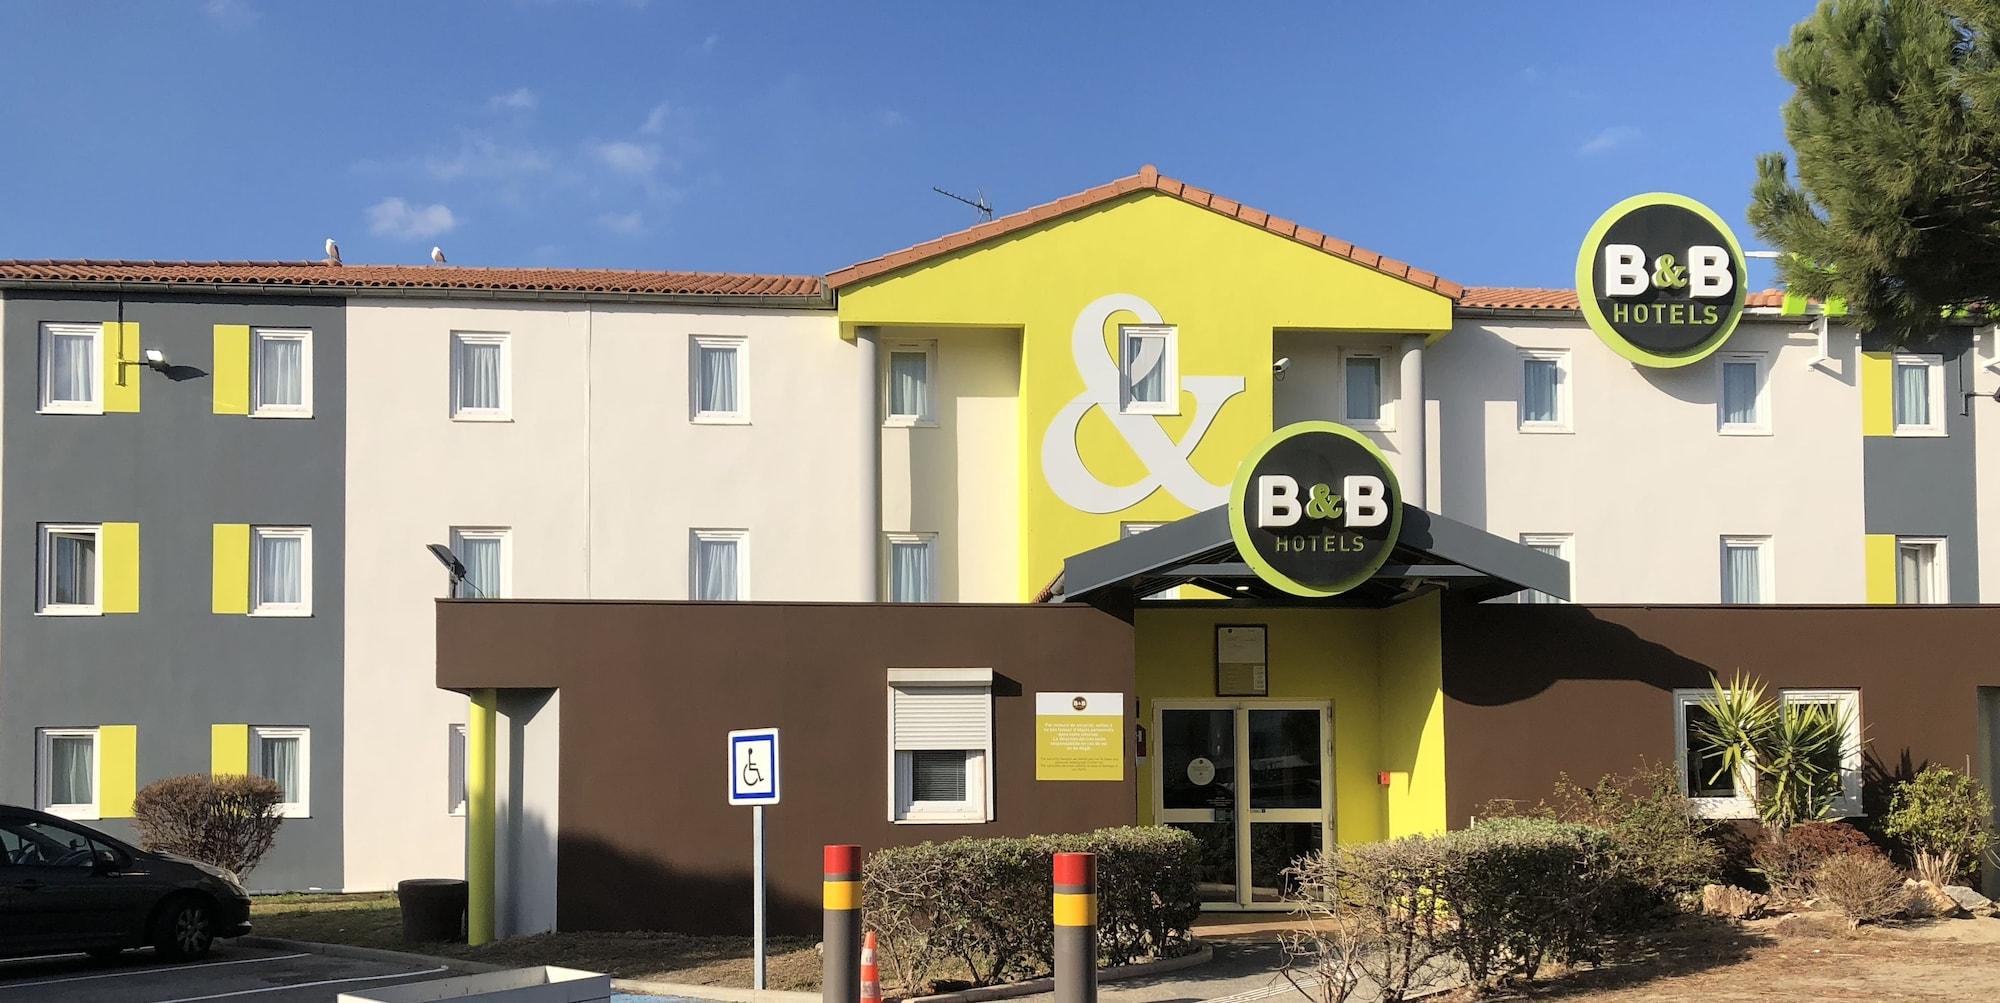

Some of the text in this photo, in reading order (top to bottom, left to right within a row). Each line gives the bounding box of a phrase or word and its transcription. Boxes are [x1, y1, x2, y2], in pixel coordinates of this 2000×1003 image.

[1605, 244, 1733, 298] B&B
[1613, 303, 1718, 325] HOTELS
[1041, 293, 1246, 514] &
[1258, 475, 1388, 528] B&B
[1275, 535, 1366, 552] HOTELS
